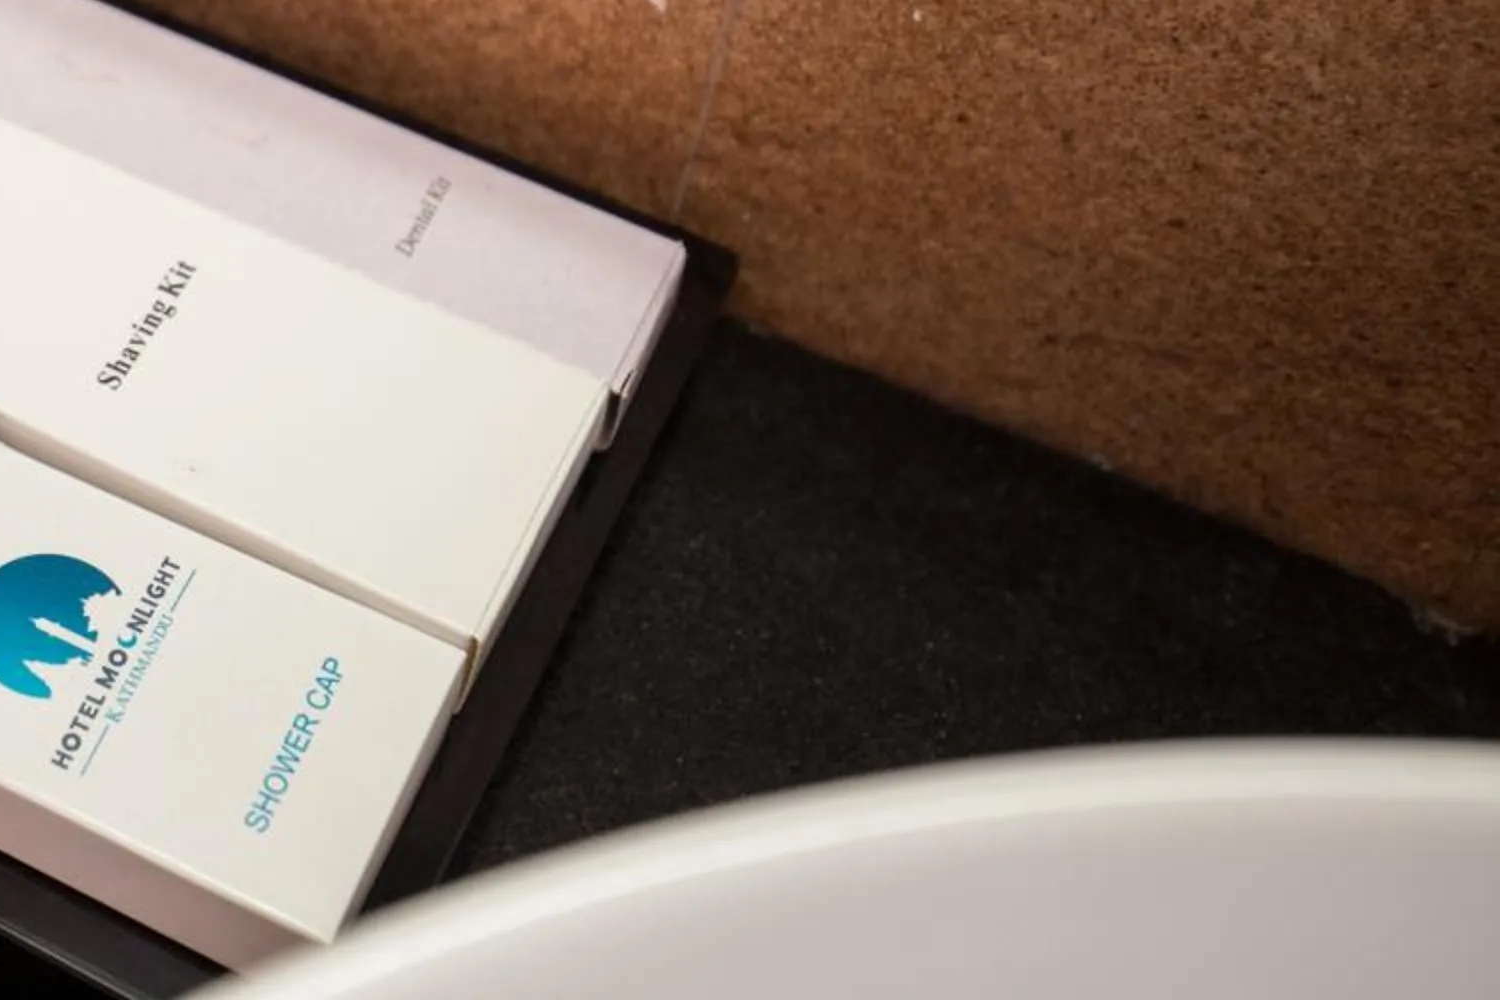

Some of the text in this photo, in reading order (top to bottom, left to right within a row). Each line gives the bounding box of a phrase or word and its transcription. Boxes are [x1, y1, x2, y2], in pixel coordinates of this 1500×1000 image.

[97, 260, 197, 391] Shaving Kit
[104, 615, 175, 724] KATHMANDU
[51, 694, 106, 770] HOTEL
[244, 656, 344, 833] SHOWER CAP
